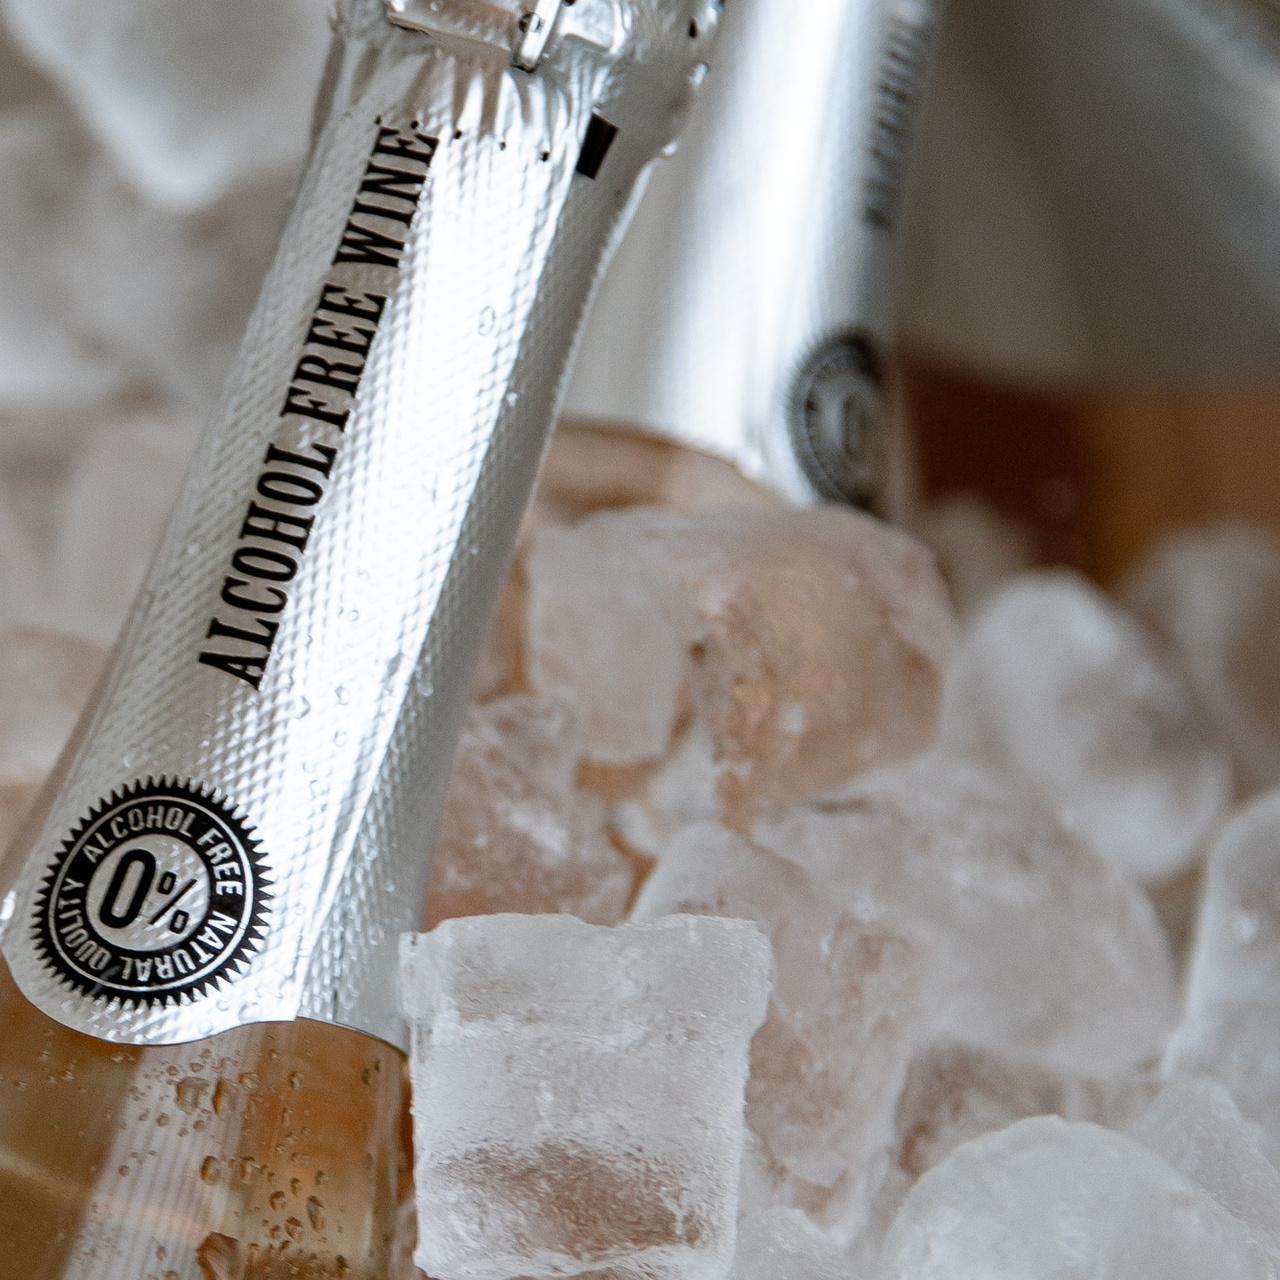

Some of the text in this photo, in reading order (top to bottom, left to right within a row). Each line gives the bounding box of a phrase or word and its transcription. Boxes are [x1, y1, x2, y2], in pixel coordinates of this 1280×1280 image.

[198, 126, 440, 690] ALCOHOL FREE WINE
[82, 805, 244, 897] ALCOHOL FREE
[98, 848, 198, 935] 0%
[119, 910, 238, 982] NATURAL
